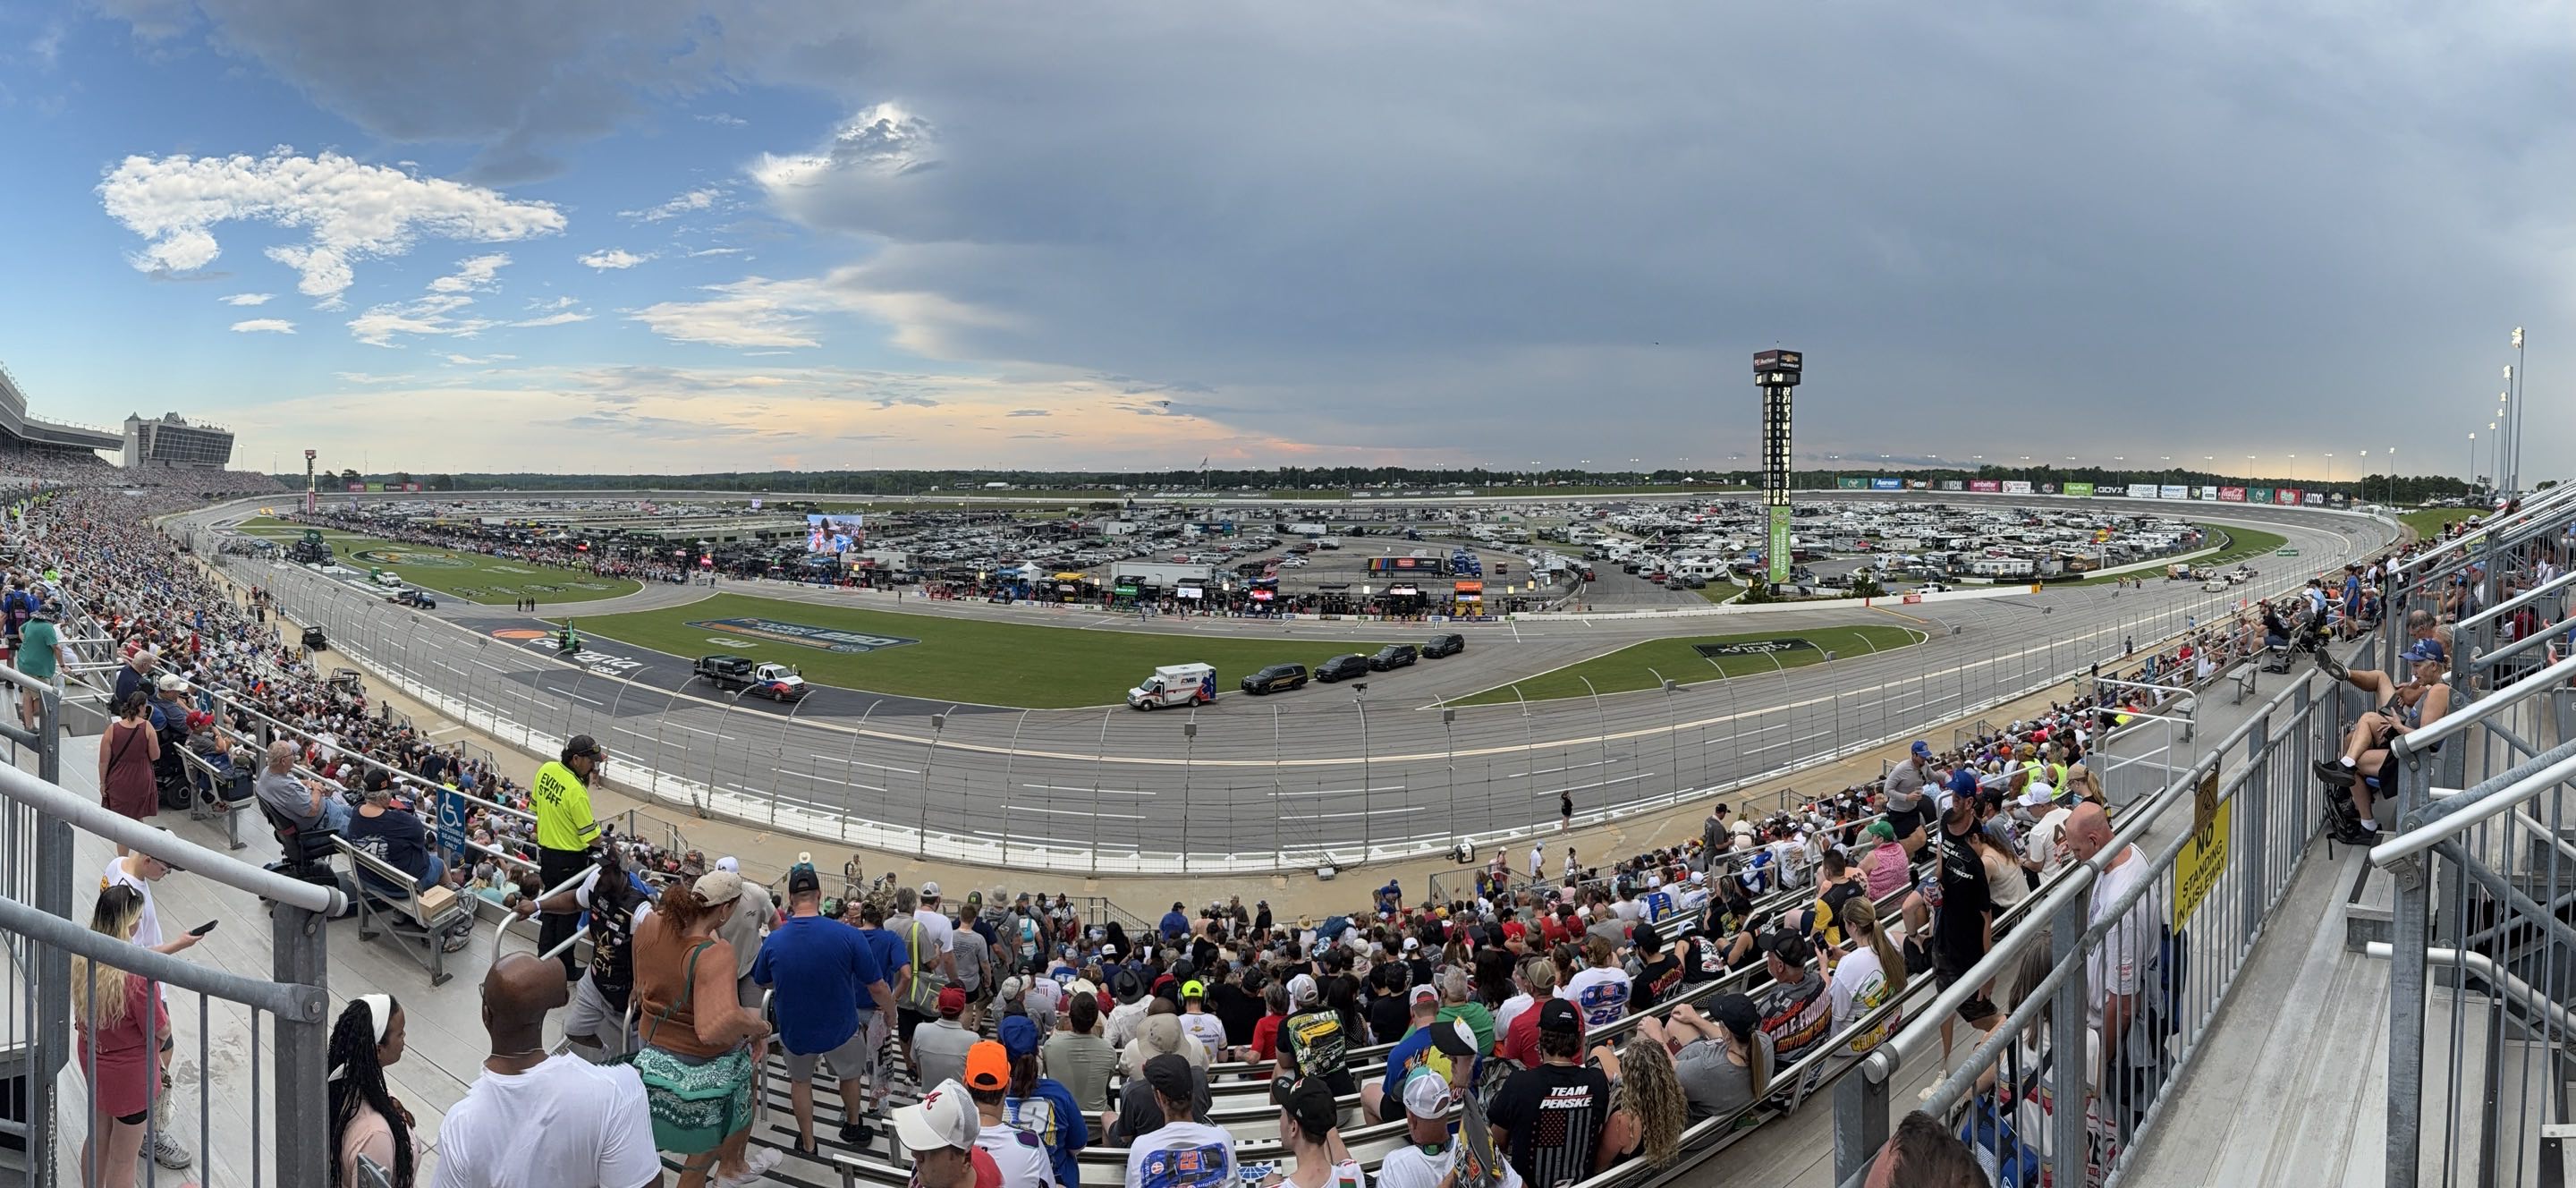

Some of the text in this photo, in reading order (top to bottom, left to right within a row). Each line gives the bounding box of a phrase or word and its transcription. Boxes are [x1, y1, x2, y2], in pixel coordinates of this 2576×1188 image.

[1949, 480, 1962, 490] VEGAS
[2221, 488, 2242, 501] Coca-Cola
[706, 637, 758, 649] CW
[809, 632, 900, 646] 250
[530, 638, 643, 669] Gergia
[1717, 643, 1792, 653] xfinity
[590, 665, 623, 675] USA
[1181, 677, 1197, 685] AMR
[2103, 680, 2115, 694] 164
[540, 772, 566, 795] EVENT
[538, 784, 563, 807] STAFF
[438, 824, 464, 838] ACCESSIBLE
[441, 833, 462, 845] SEATING
[2195, 821, 2215, 861] NO
[445, 841, 458, 852] ONLY
[2182, 839, 2223, 899] STANDING
[2176, 852, 2226, 928] IN AISLEWAY
[1313, 1009, 1339, 1021] BELL
[1588, 1004, 1623, 1026] 22
[1770, 1016, 1797, 1043] DALE
[1776, 1026, 1814, 1052] DAYTONA
[1297, 1047, 1311, 1063] 20
[1551, 1085, 1589, 1097] TEAM
[1539, 1097, 1592, 1109] PENSKE
[1180, 1150, 1199, 1171] 22
